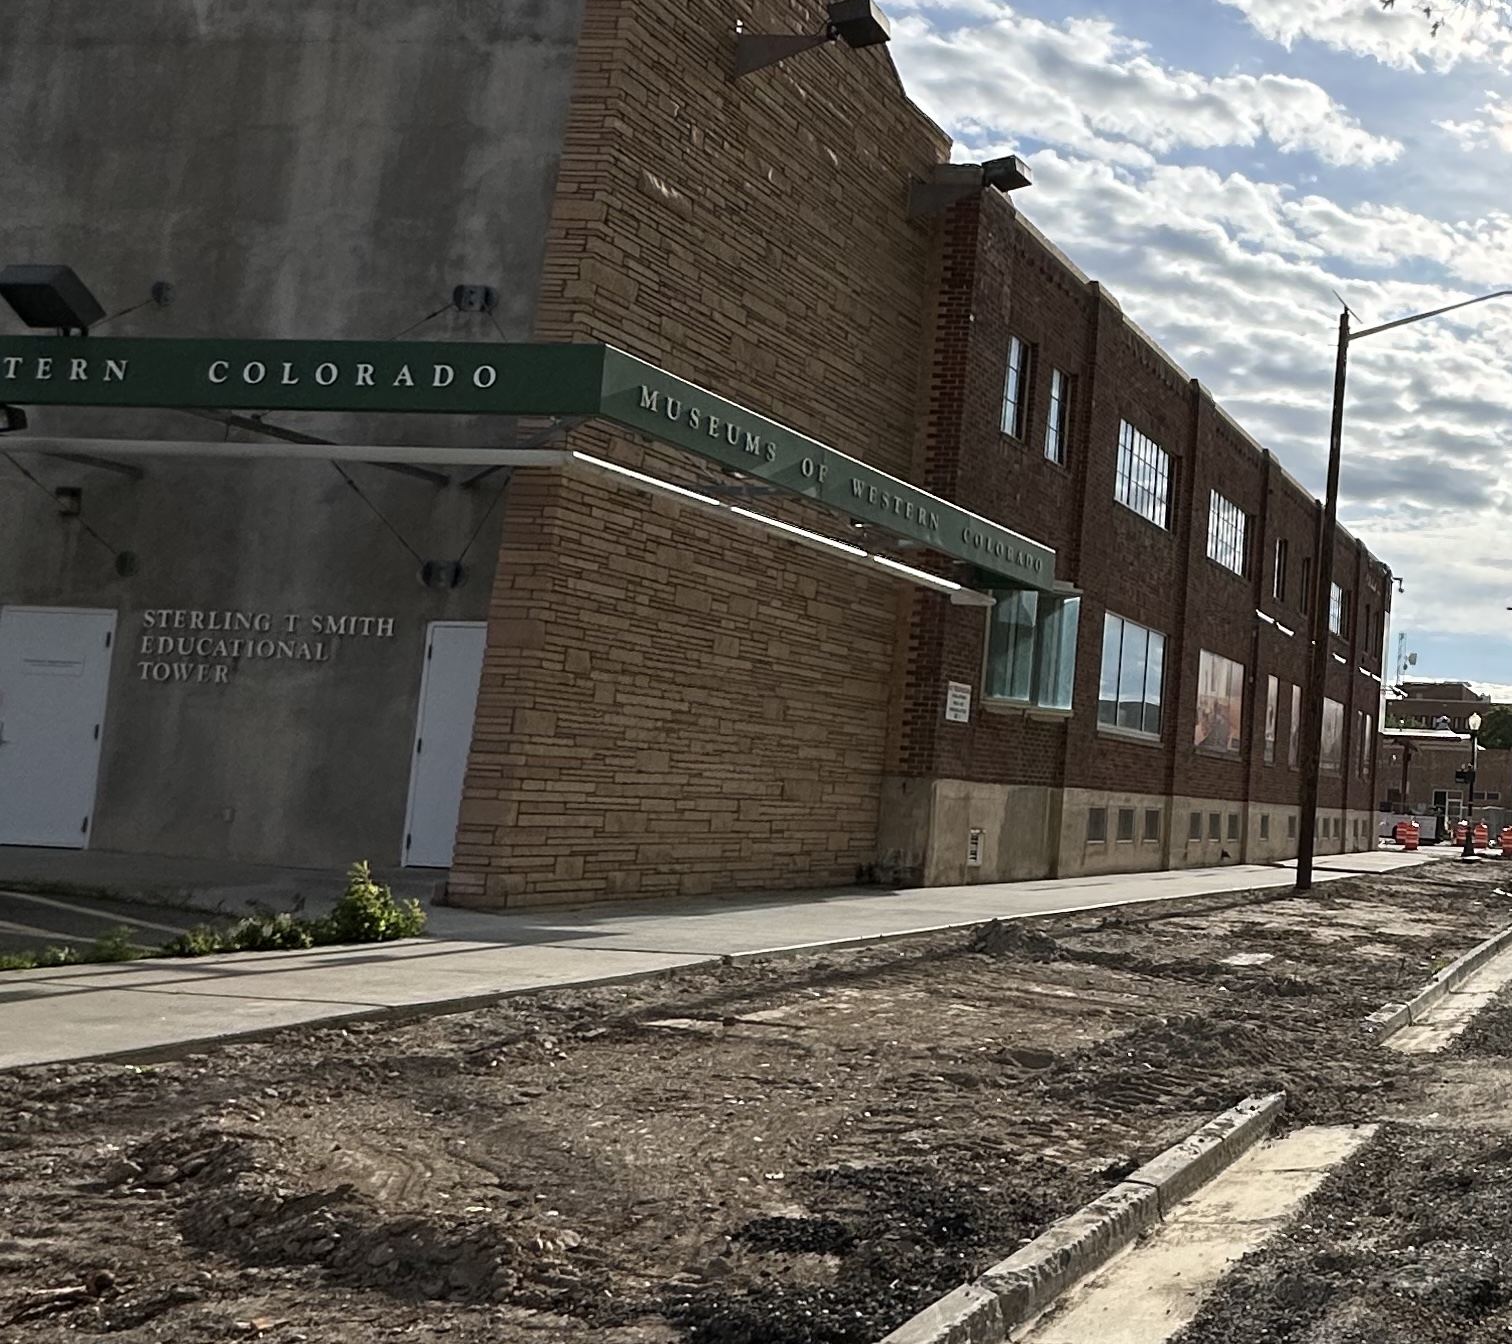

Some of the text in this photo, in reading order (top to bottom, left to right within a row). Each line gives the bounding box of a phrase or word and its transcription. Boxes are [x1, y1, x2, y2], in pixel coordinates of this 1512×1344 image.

[3, 357, 498, 388] TERN COLORADO
[639, 384, 1044, 573] MUSEUMS OF WESTERN COLORADO
[143, 609, 396, 637] STERLING T SMITH
[140, 635, 331, 661] EDUCATIONAL
[137, 661, 230, 684] TOWER
